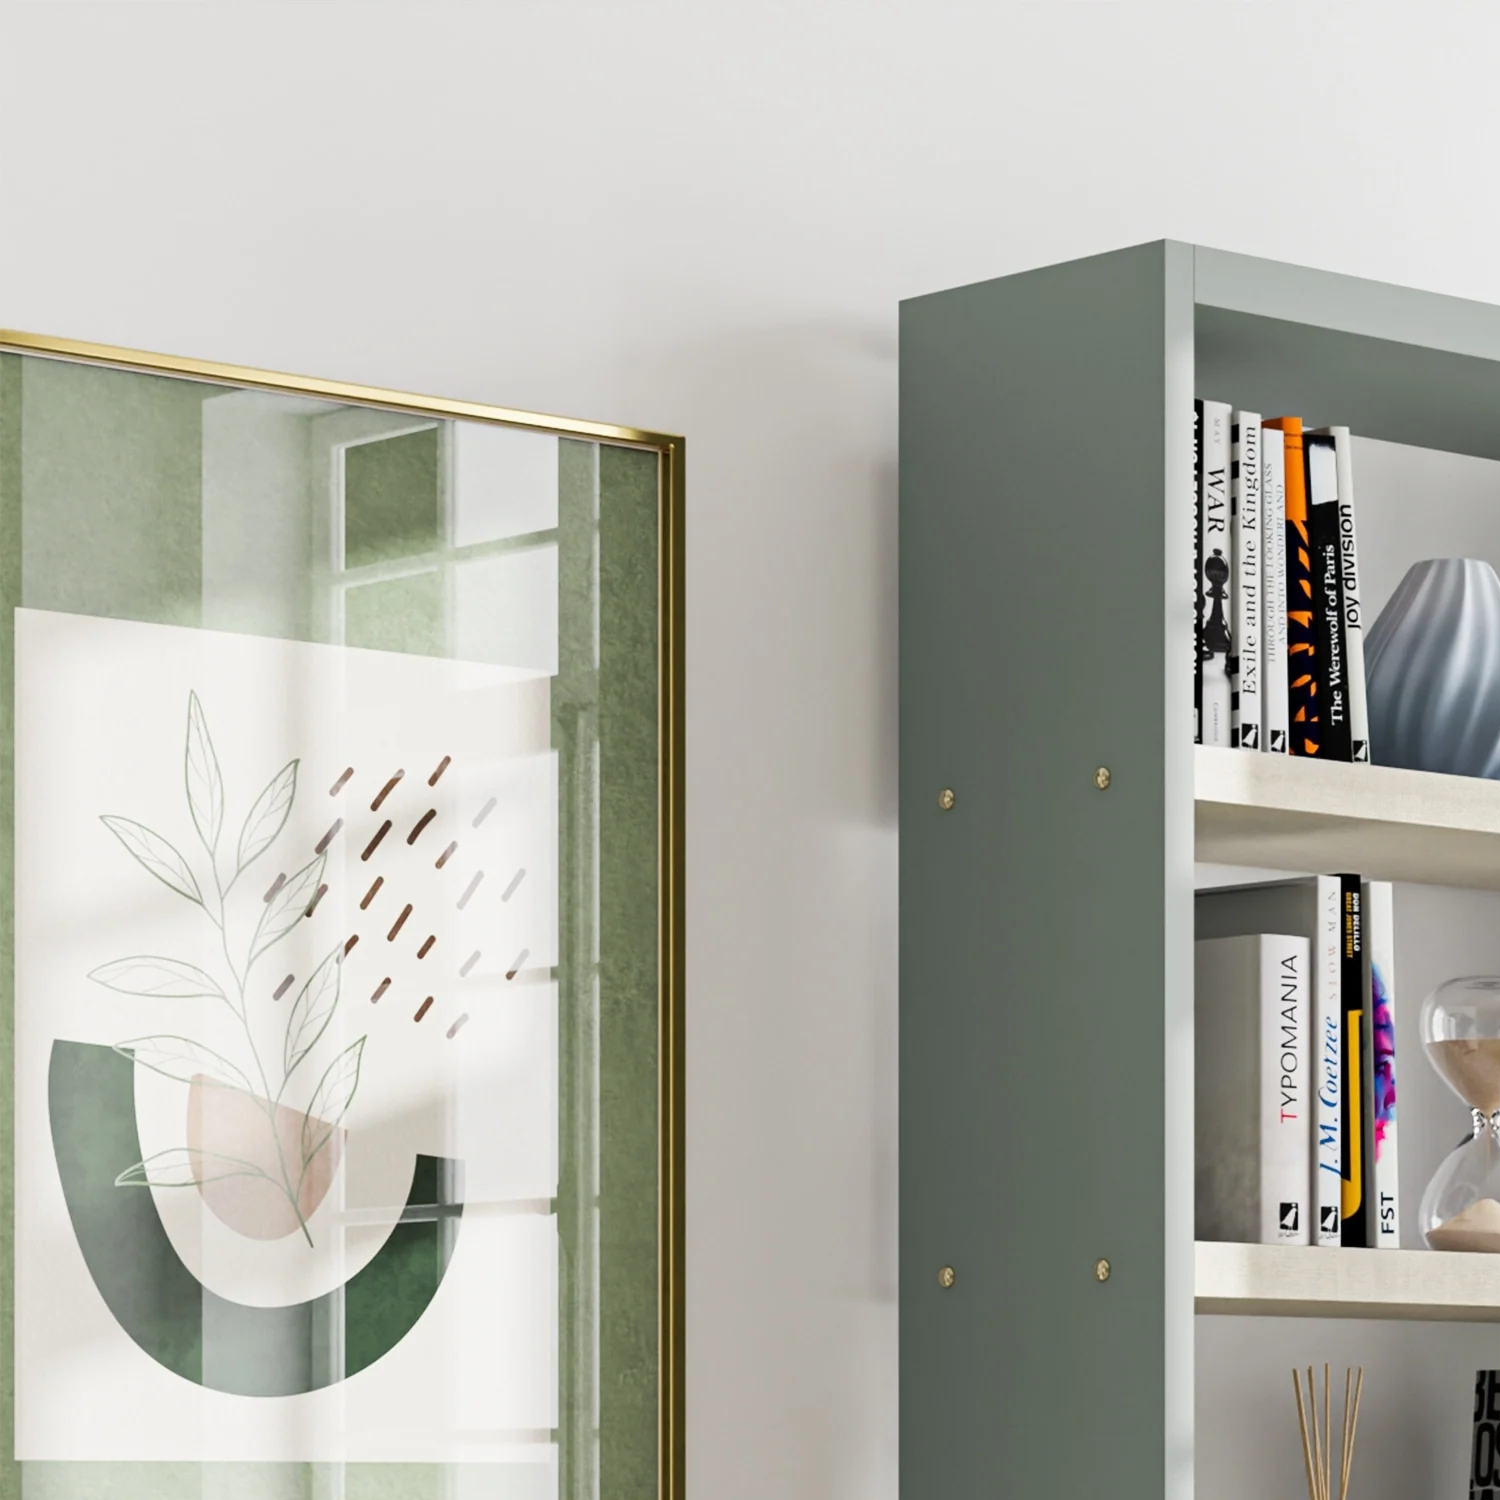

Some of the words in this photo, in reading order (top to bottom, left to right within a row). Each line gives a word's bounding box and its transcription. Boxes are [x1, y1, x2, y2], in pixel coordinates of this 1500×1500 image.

[1242, 425, 1260, 530] Kingdom
[1264, 463, 1273, 504] GLASS
[1208, 467, 1225, 533] WAR
[1266, 507, 1274, 569] LOOKING
[1275, 484, 1285, 581] WONDERLAND
[1338, 504, 1357, 591] division
[1243, 539, 1257, 576] the
[1323, 544, 1336, 585] Paris
[1243, 584, 1257, 627] and
[1324, 589, 1337, 606] of
[1344, 596, 1362, 630] joy
[1267, 599, 1275, 664] THROUGH
[1278, 617, 1286, 645] AND
[1326, 608, 1342, 686] Werewolf
[1242, 634, 1257, 695] Exile
[1330, 689, 1343, 725] The
[1327, 891, 1337, 931] MAN
[1280, 954, 1298, 1124] TYPOMANIA
[1319, 1016, 1338, 1107] Coetzee
[1320, 1117, 1338, 1151] M.
[1381, 1192, 1395, 1234] FST
